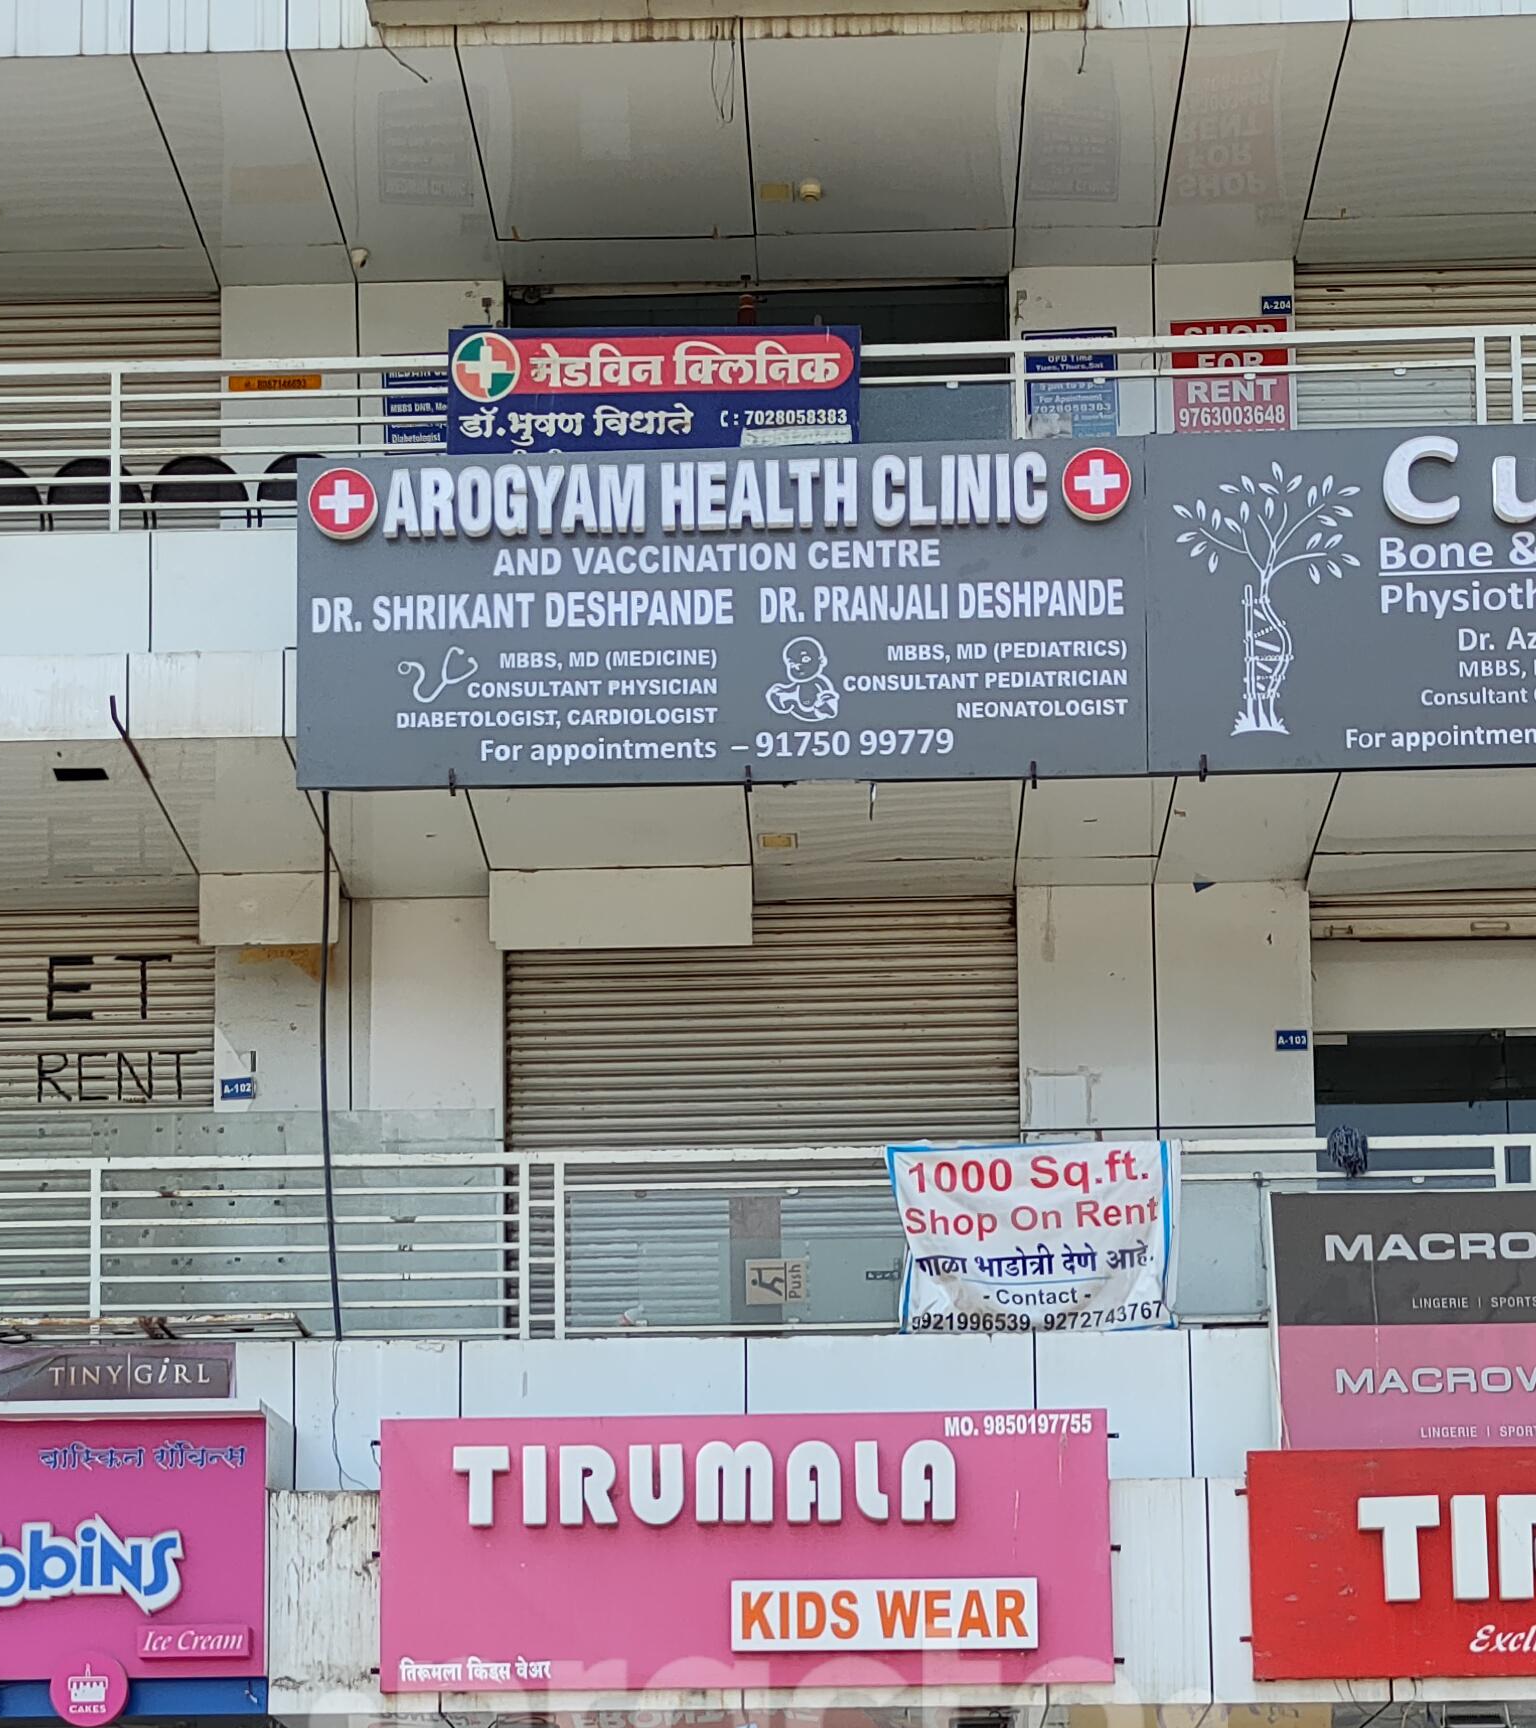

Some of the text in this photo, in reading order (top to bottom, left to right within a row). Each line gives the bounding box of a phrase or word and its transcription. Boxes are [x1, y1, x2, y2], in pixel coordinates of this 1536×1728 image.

[1263, 301, 1291, 310] A-204
[528, 338, 842, 389] मेडविन क्लिनिक
[1187, 378, 1278, 405] RENT
[1178, 405, 1286, 428] 9763003648
[382, 452, 1049, 540] AROGYAM HEALTH CLINIC
[493, 538, 941, 576] AND VACCINATION CENTRE
[1378, 535, 1494, 569] Bone
[311, 588, 734, 635] DR. SHRIKANT DESHPANDE
[760, 578, 1125, 624] DR. PRANJALI DESHPANDE
[993, 638, 1128, 661] (PEDIATRICS)
[1458, 628, 1496, 653] Dr.
[605, 648, 718, 671] (MEDICINE)
[843, 669, 1128, 692] CONSULTANT PEDIATRICIAN
[956, 698, 1128, 719] NEONATOLOGIST
[755, 725, 955, 760] 91750 99779
[1277, 1035, 1307, 1046] A-103
[37, 1050, 199, 1104] RENT
[222, 1082, 253, 1097] A-102
[908, 1149, 1150, 1195] 1000 Sq.ft.
[904, 1196, 1160, 1242] Shop On Rent
[996, 1287, 1079, 1306] Contact
[1411, 1297, 1470, 1309] LINGERIE
[1043, 1299, 1163, 1331] 9272743767
[945, 1412, 1093, 1438] MO. 9850197755
[452, 1438, 958, 1528] TIRUMALA
[740, 1588, 1030, 1641] KIDS WEAR
[143, 1630, 245, 1652] Ice Cream
[69, 1704, 106, 1714] CAKES
